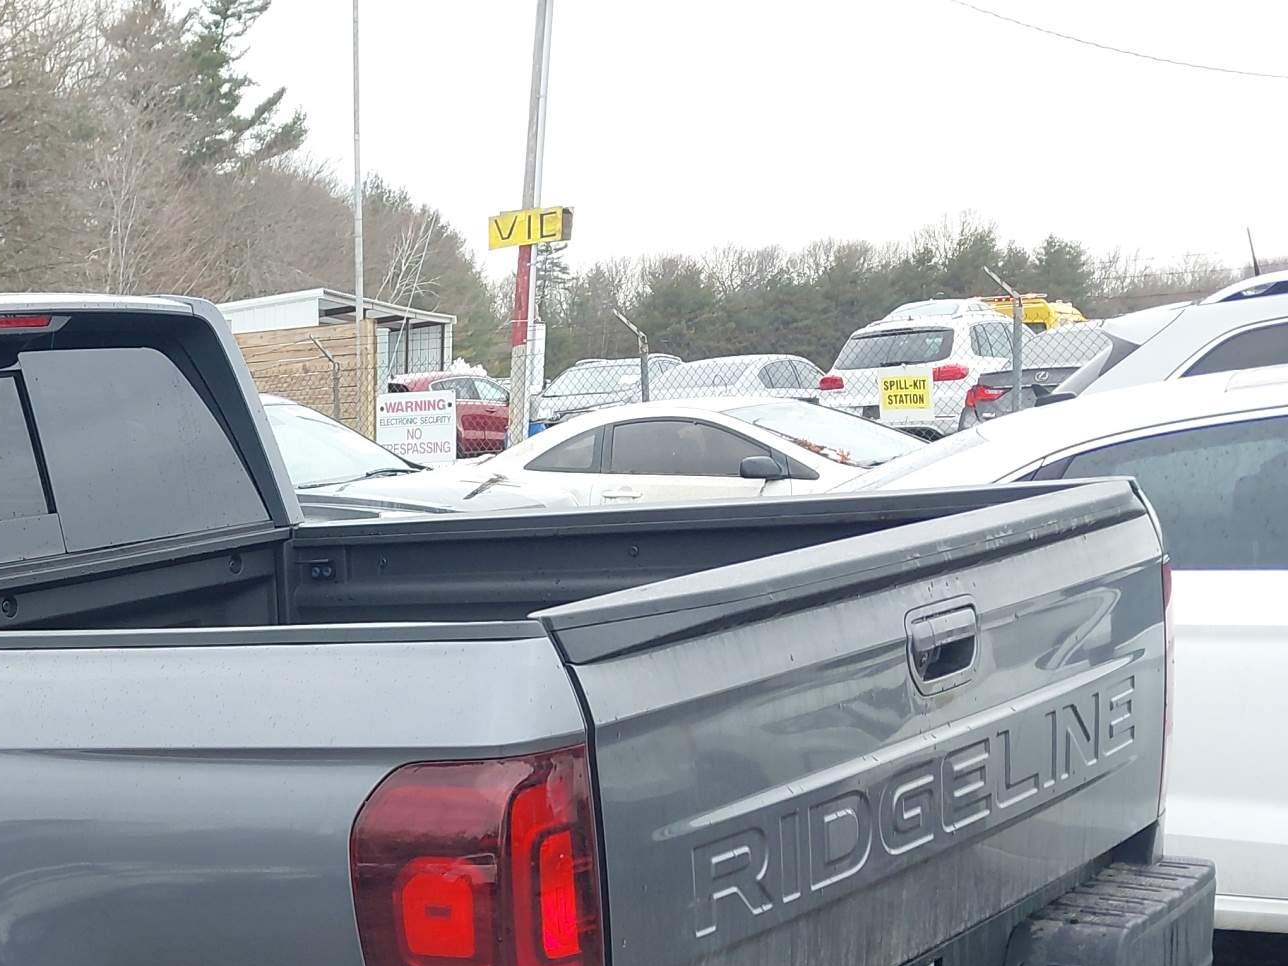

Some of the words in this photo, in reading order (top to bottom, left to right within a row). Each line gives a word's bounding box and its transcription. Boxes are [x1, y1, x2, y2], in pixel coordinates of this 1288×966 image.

[883, 379, 926, 391] SPILL-KIT
[887, 394, 925, 405] STATION
[384, 399, 446, 413] WARNING
[379, 417, 418, 426] ELECTRONIC
[420, 415, 452, 425] SECURITY
[406, 427, 422, 440] NO
[692, 674, 1136, 938] RIDGELINE
